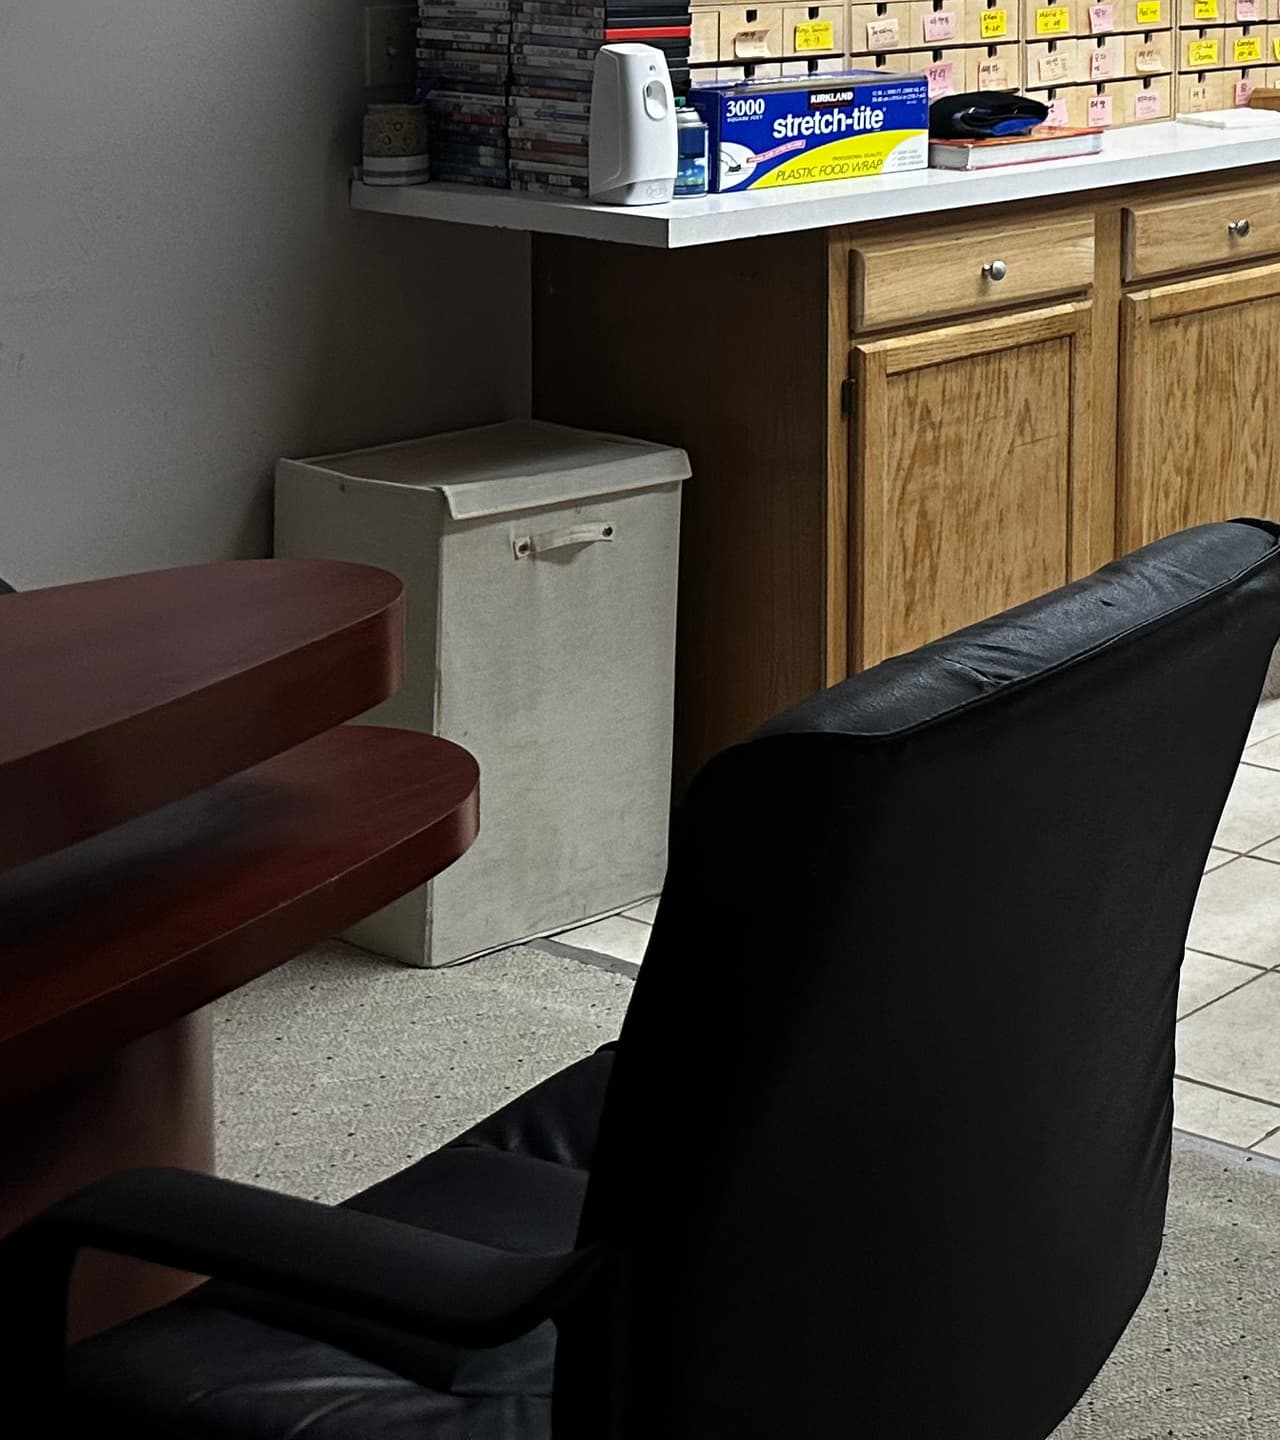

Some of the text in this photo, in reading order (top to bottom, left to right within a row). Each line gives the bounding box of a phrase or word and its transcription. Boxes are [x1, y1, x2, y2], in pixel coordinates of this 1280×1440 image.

[726, 98, 765, 117] 3000
[810, 91, 854, 104] KIRKLAND
[773, 105, 884, 139] stretch-tite
[775, 159, 883, 182] PLASTIC FOOD WRAP
